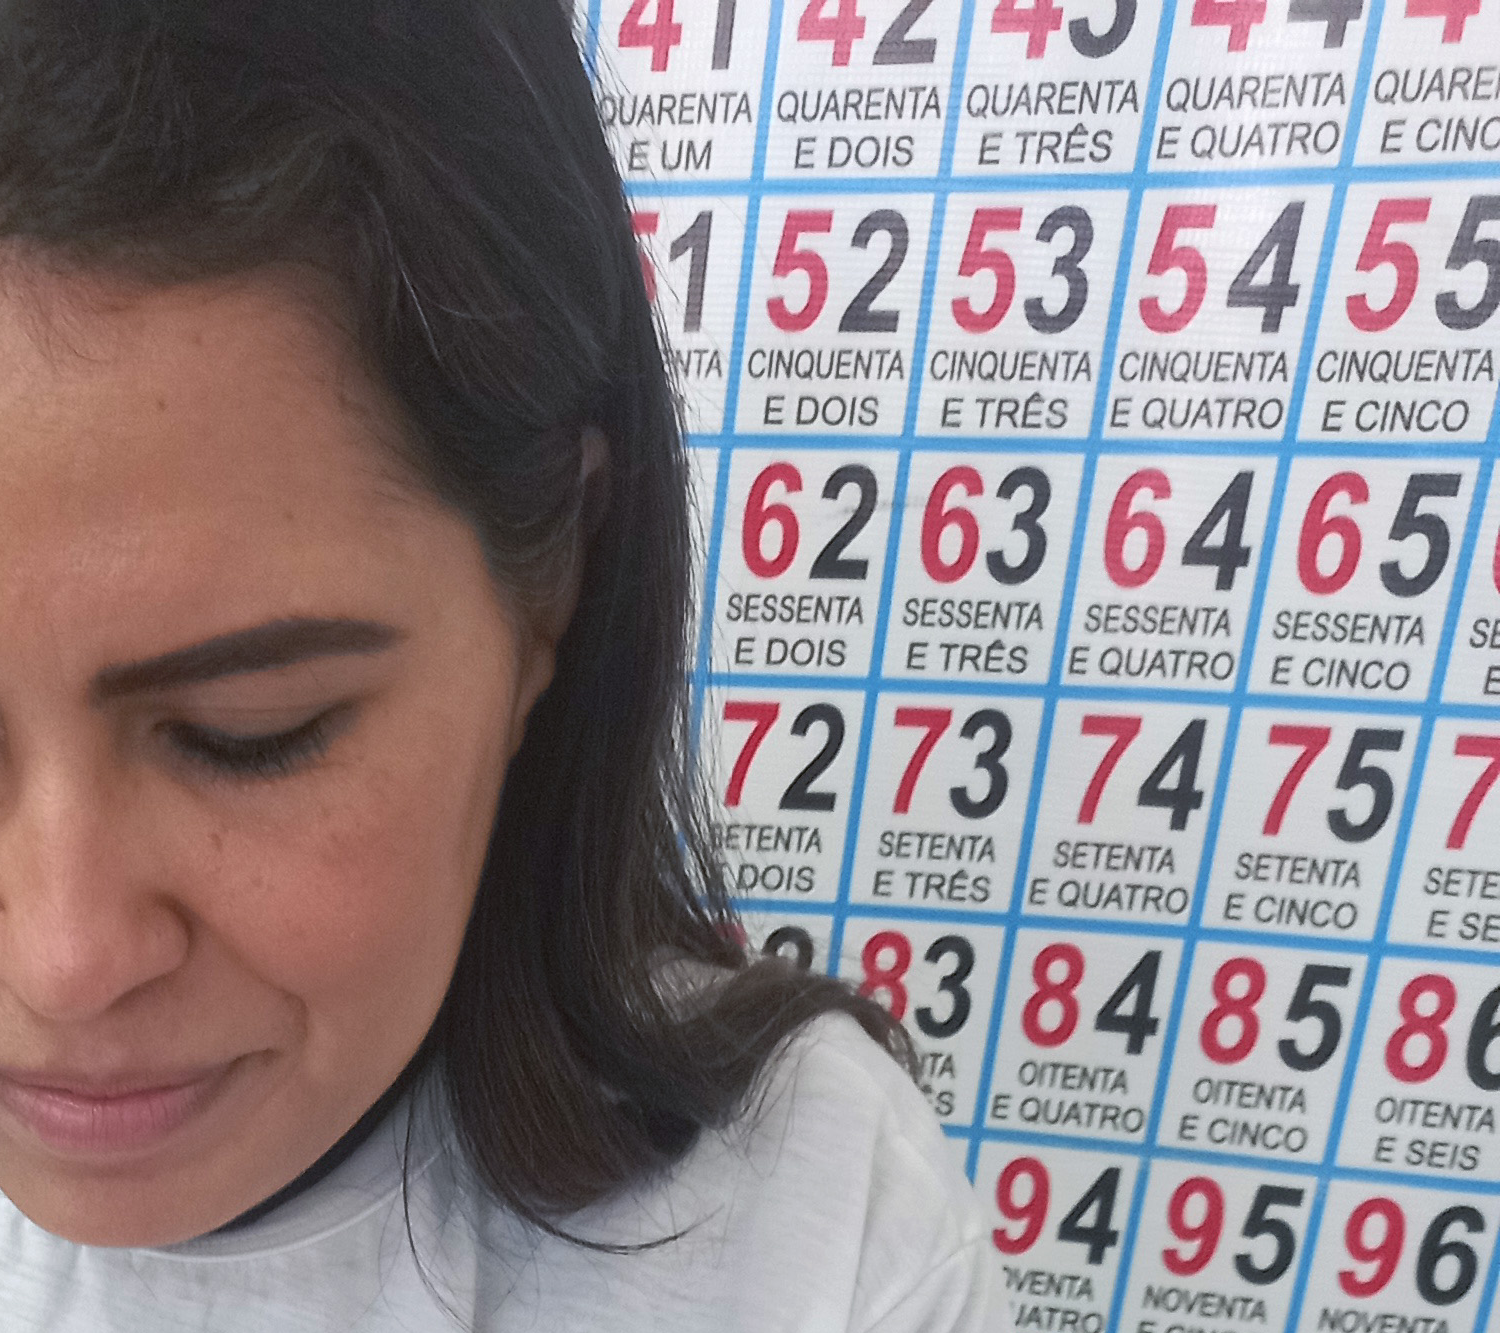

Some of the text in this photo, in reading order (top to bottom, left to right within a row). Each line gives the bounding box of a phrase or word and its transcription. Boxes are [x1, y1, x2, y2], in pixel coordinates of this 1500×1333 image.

[966, 79, 1140, 118] QUARENTA
[1166, 72, 1346, 113] QUARENTA
[1374, 65, 1500, 105] QUARE
[600, 91, 752, 126] QUARENTA
[776, 86, 941, 124] QUARENTA
[628, 139, 713, 171] E UM
[794, 135, 915, 169] E DOIS
[978, 122, 1113, 165] E TRÊS
[1156, 120, 1341, 159] E QUATRO
[1380, 118, 1407, 154] E
[766, 208, 910, 333] 52
[951, 205, 1094, 334] 53
[1138, 200, 1305, 333] 54
[1345, 195, 1500, 333] 55
[748, 348, 905, 382] CINQUENTA
[930, 349, 1093, 383] CINQUENTA
[1118, 350, 1290, 384] CINQUENTA
[1316, 348, 1495, 385] CINQUENTA
[763, 395, 880, 426] E DOIS
[941, 391, 1069, 430] E TRÊS
[1110, 397, 1284, 430] E QUATRO
[1321, 399, 1470, 433] E CINCO
[741, 461, 879, 581] 62
[920, 464, 1052, 585] 63
[1103, 467, 1255, 591] 64
[1296, 470, 1463, 598] 65
[726, 593, 865, 625] SESSENTA
[902, 598, 1044, 632] SESSENTA
[1084, 603, 1232, 637] SESSENTA
[1272, 610, 1426, 646] SESSENTA
[734, 637, 848, 668] E DOIS
[906, 638, 1029, 675] E TRÊS
[1068, 646, 1236, 682] E QUATRO
[1270, 656, 1412, 691] E CINCO
[723, 701, 846, 812] 72
[892, 706, 1013, 819] 73
[1077, 714, 1207, 832] 74
[1261, 723, 1405, 844] 75
[878, 830, 996, 863] SETENTA
[1052, 841, 1176, 875] SETENTA
[736, 863, 816, 893] DOIS
[872, 869, 991, 903] E TRÊS
[1235, 852, 1362, 889] SETENTA
[1028, 878, 1190, 915] E QUATRO
[1224, 892, 1359, 931] E CINCO
[1426, 909, 1451, 938] E
[858, 929, 976, 1039] 83
[1020, 942, 1163, 1055] 84
[1199, 955, 1352, 1073] 85
[1018, 1060, 1129, 1095] OITENTA
[1192, 1076, 1308, 1115] OITENTA
[989, 1093, 1011, 1120] E
[1018, 1098, 1145, 1134] QUATRO
[1374, 1096, 1496, 1134] OITENTA
[1176, 1114, 1308, 1154] E CINCO
[1373, 1135, 1481, 1172] E SEIS
[991, 1155, 1122, 1266] 94
[1161, 1174, 1305, 1286] 95
[1338, 1196, 1487, 1307] 96
[1141, 1284, 1267, 1323] NOVENTA
